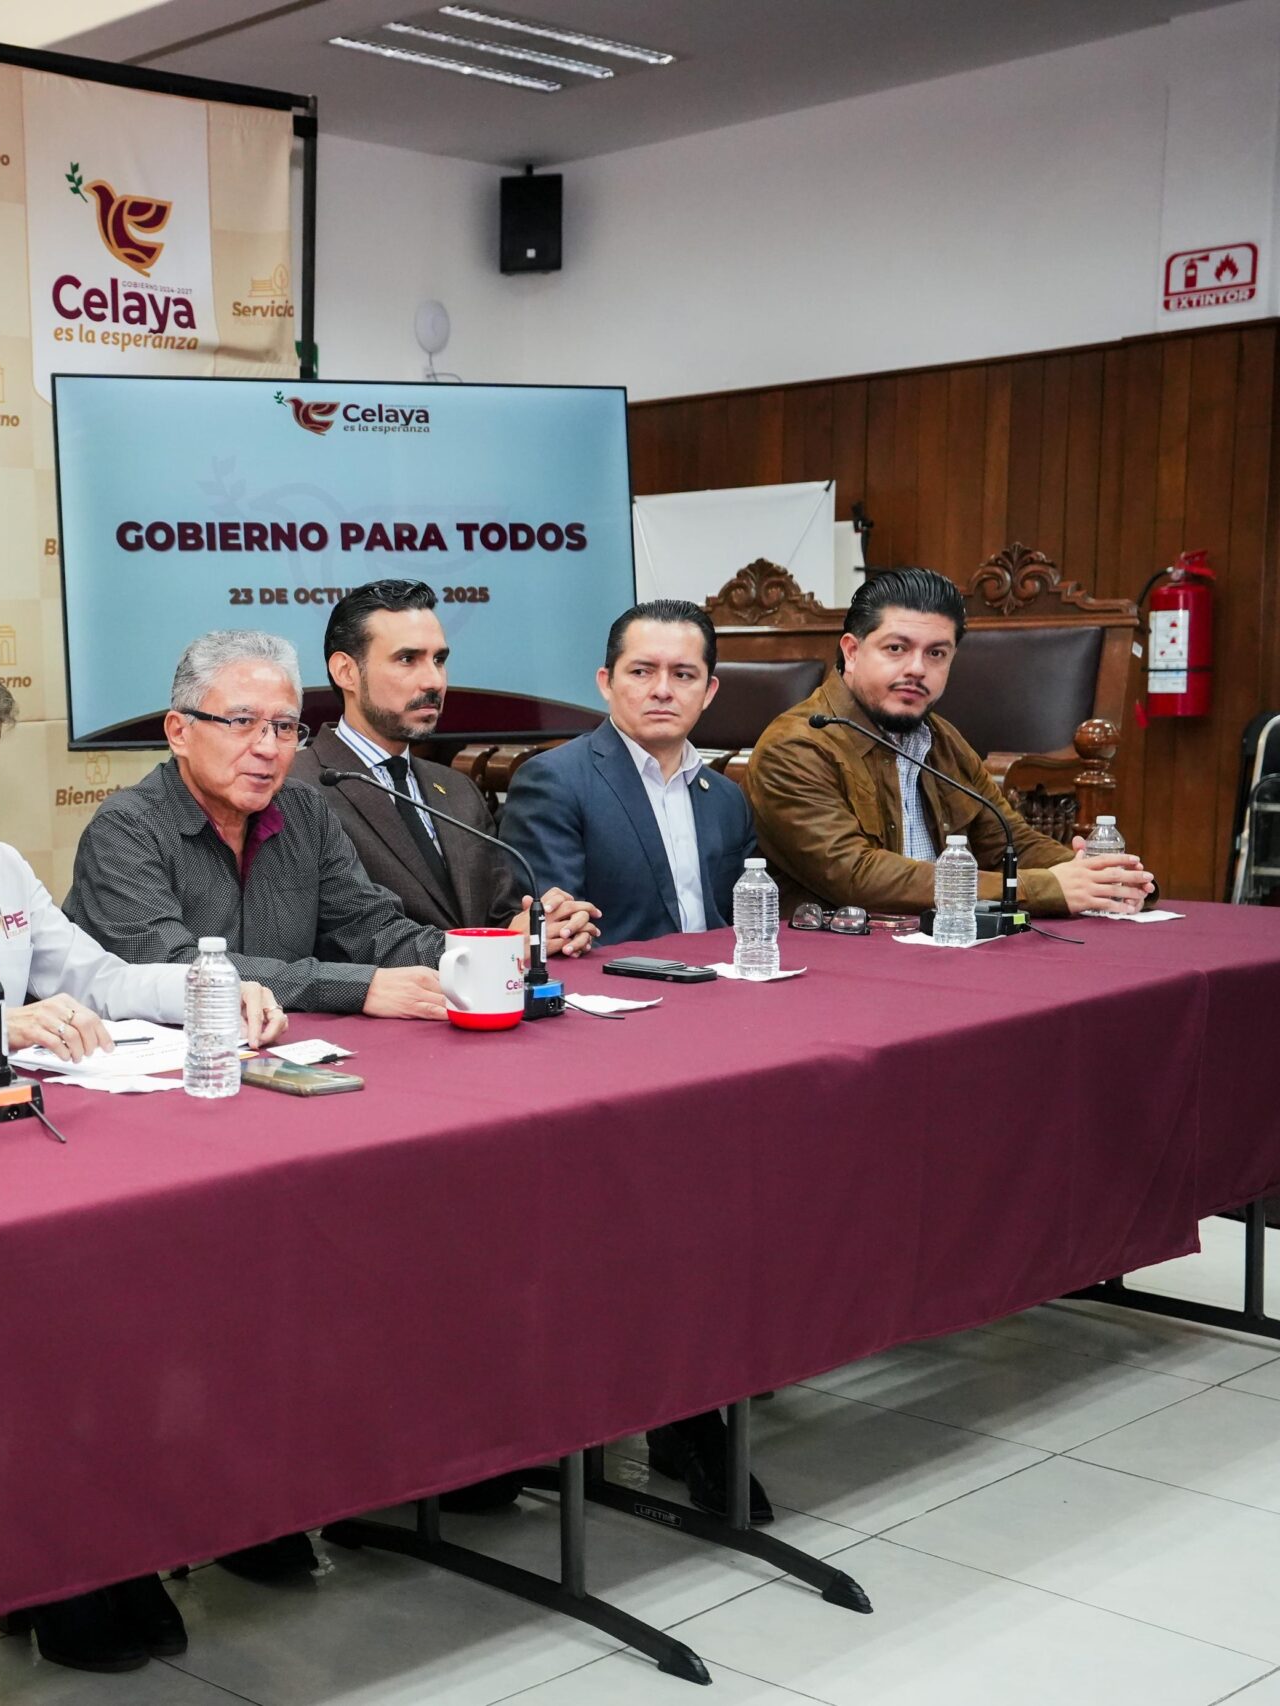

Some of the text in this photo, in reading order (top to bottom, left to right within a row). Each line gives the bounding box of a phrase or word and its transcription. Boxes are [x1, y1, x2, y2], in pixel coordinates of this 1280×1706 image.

[52, 274, 196, 334] Celaya
[232, 300, 294, 317] Servicio
[1170, 288, 1249, 310] EXTINTOR
[53, 323, 199, 352] es la esperanza
[342, 404, 430, 426] Celaya
[343, 423, 430, 434] es la esperanza
[116, 521, 588, 552] GOBIERNO PARA TODOS
[228, 587, 362, 605] 23 DE OCTU
[442, 586, 491, 604] 2025
[55, 785, 120, 806] Biene
